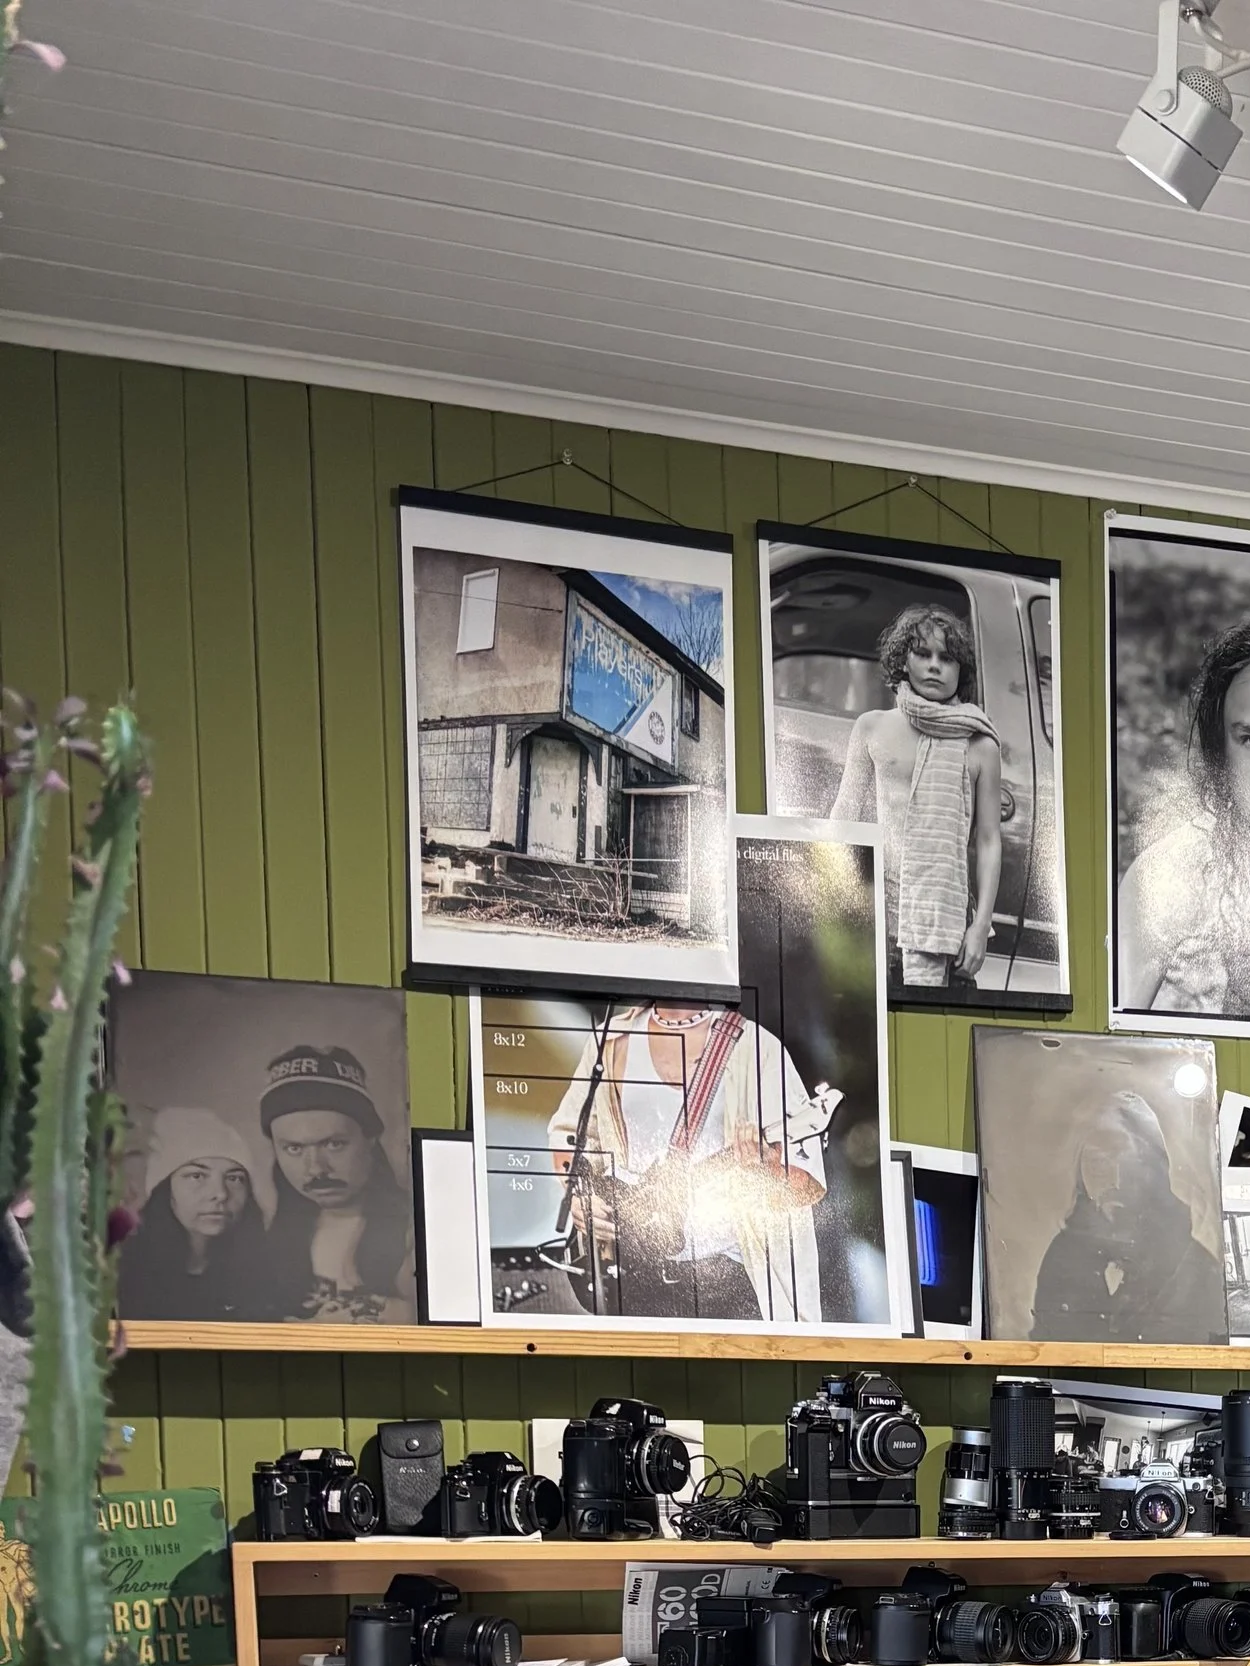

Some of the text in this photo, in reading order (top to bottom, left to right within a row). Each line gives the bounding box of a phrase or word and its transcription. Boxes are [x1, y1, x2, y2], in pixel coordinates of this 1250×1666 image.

[743, 847, 804, 863] digital files
[494, 1032, 525, 1047] 8x12
[496, 1080, 528, 1095] 8x10
[507, 1154, 531, 1168] 5x7
[508, 1178, 533, 1191] 4x6
[869, 1397, 896, 1406] Nikon
[893, 1441, 917, 1449] Nikon
[335, 1457, 354, 1468] Nikon
[505, 1463, 524, 1472] Nikon
[98, 1498, 178, 1531] APOLLO
[145, 1543, 181, 1555] FINISH
[106, 1558, 180, 1595] Chrome
[953, 1584, 966, 1592] Nikon
[1193, 1580, 1210, 1588] Nikon
[628, 1577, 643, 1606] Nikon
[113, 1595, 226, 1635] ROTYPE
[503, 1633, 512, 1664] Nikon
